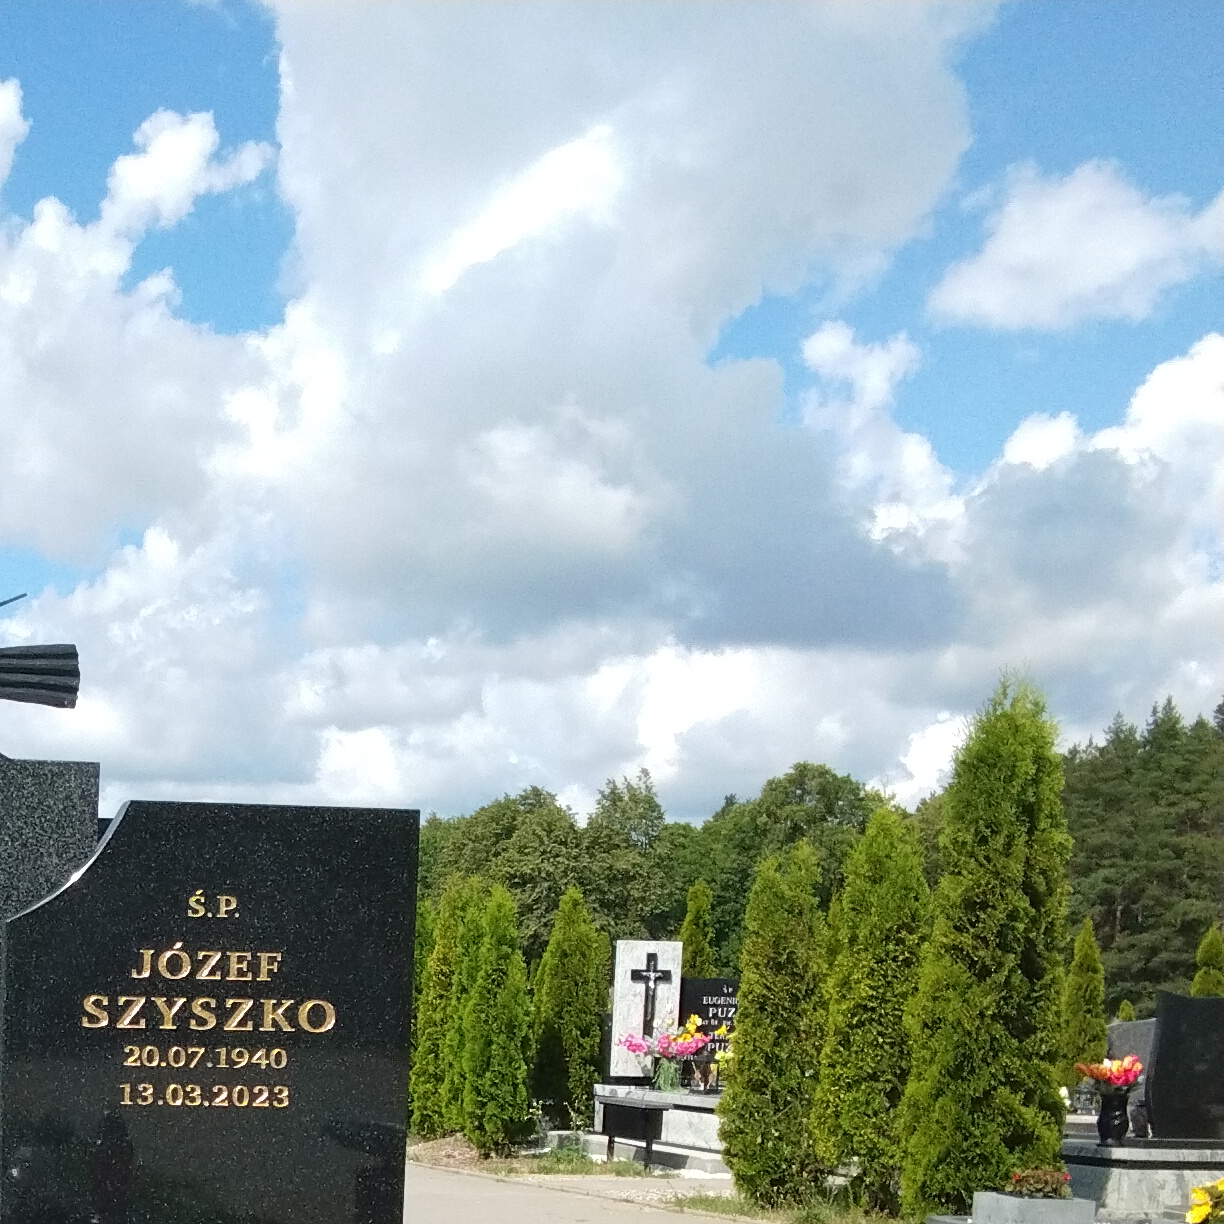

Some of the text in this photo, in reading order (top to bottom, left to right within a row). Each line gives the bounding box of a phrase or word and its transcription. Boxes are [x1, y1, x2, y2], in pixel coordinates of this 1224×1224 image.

[187, 890, 240, 918] Ś.P.
[131, 942, 282, 981] JÓZEF
[81, 994, 337, 1033] SZYSZKO
[123, 1045, 288, 1069] 20.07.1940
[119, 1083, 290, 1108] 13.03.2023
